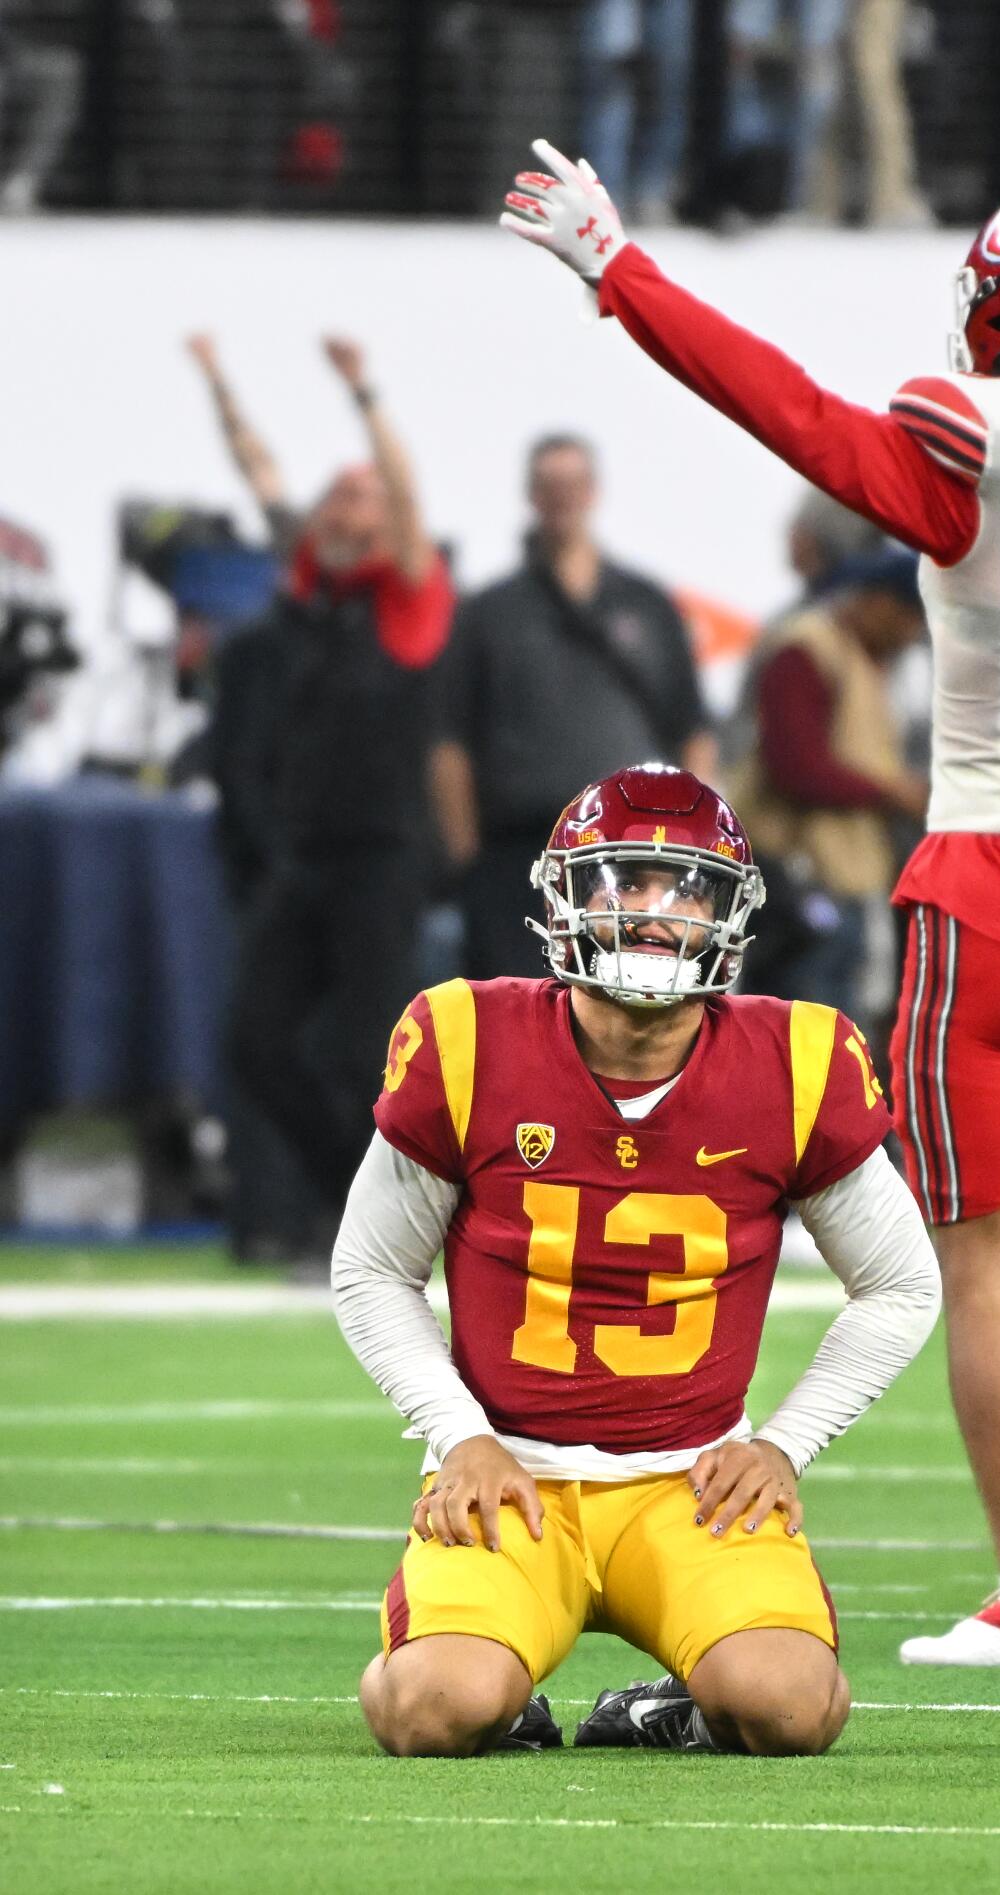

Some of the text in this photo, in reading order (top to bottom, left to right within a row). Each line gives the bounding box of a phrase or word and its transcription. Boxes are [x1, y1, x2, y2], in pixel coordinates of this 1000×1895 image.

[577, 832, 598, 845] USC
[716, 843, 736, 858] USC
[518, 1126, 554, 1149] PAC
[525, 1143, 544, 1160] 12
[616, 1136, 639, 1168] SC
[511, 1181, 728, 1376] 13
